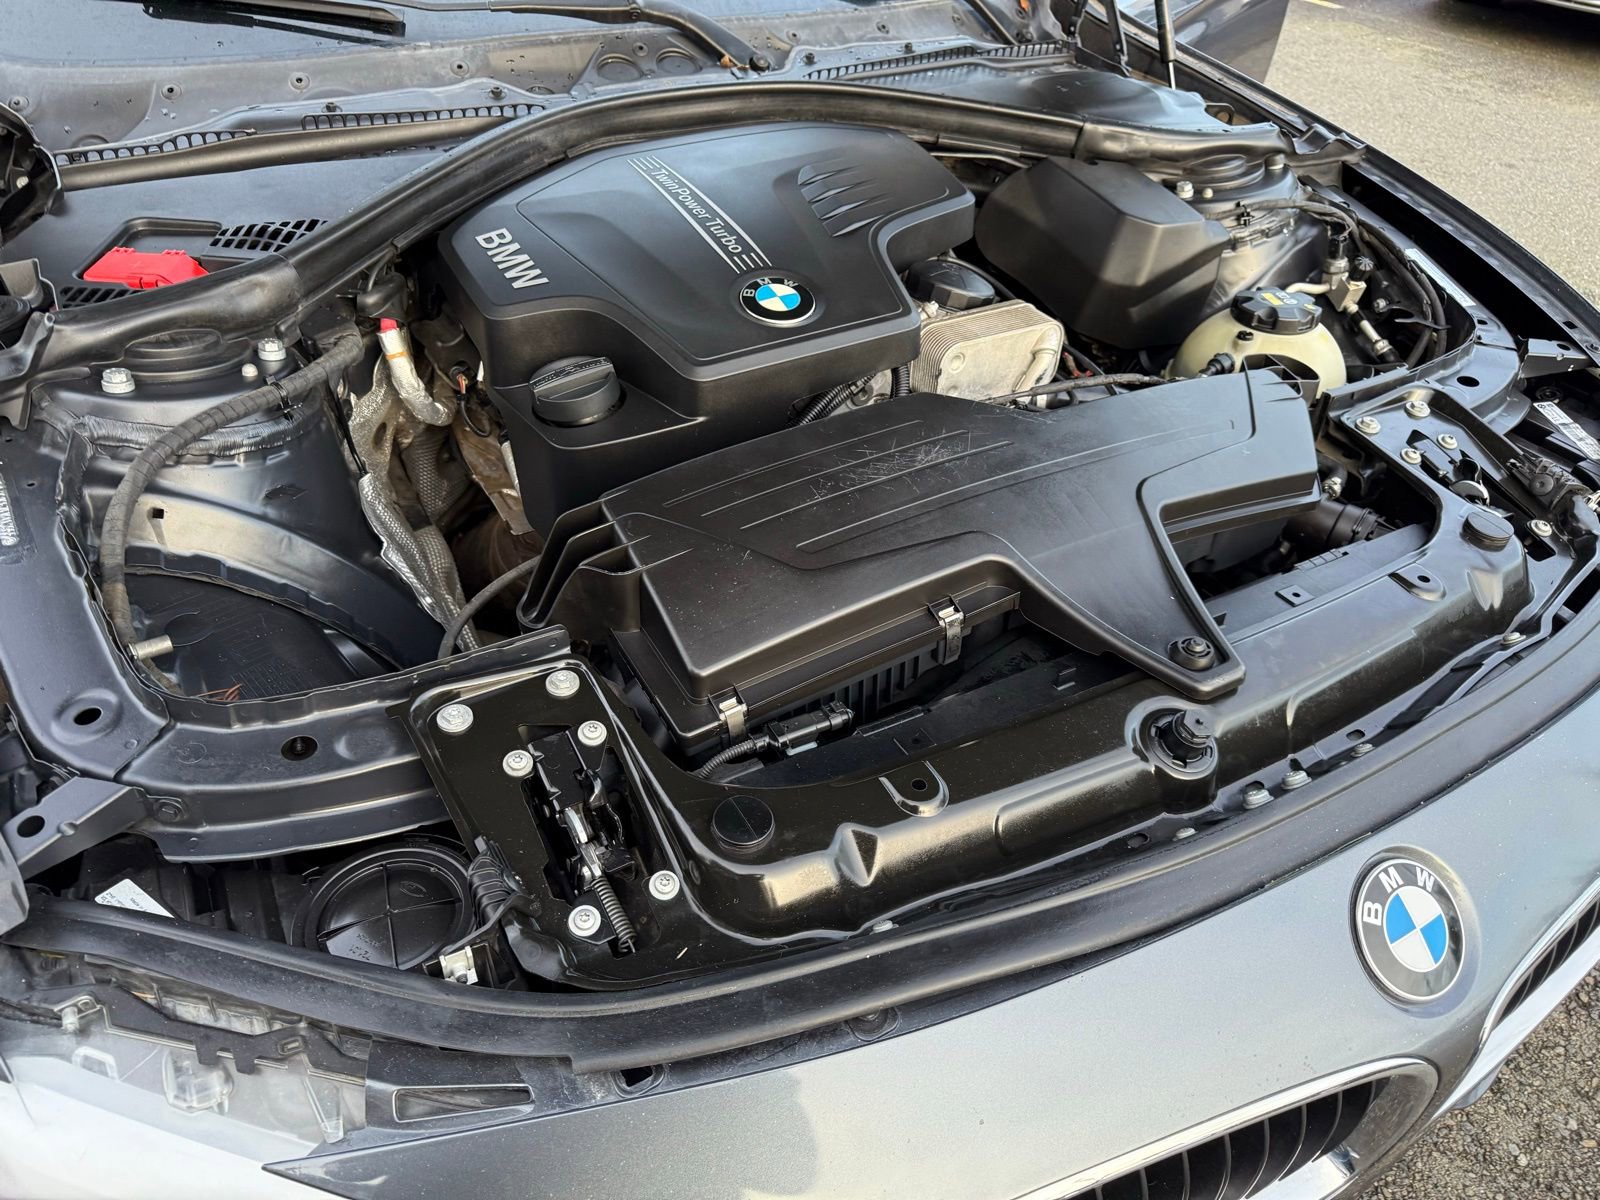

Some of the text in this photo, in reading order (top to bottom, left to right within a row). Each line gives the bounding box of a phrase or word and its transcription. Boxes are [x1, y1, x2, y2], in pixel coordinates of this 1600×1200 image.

[651, 169, 742, 253] TwinPower Turbo
[475, 227, 550, 289] BMW
[742, 277, 799, 297] BMW
[1362, 866, 1436, 927] BMW
